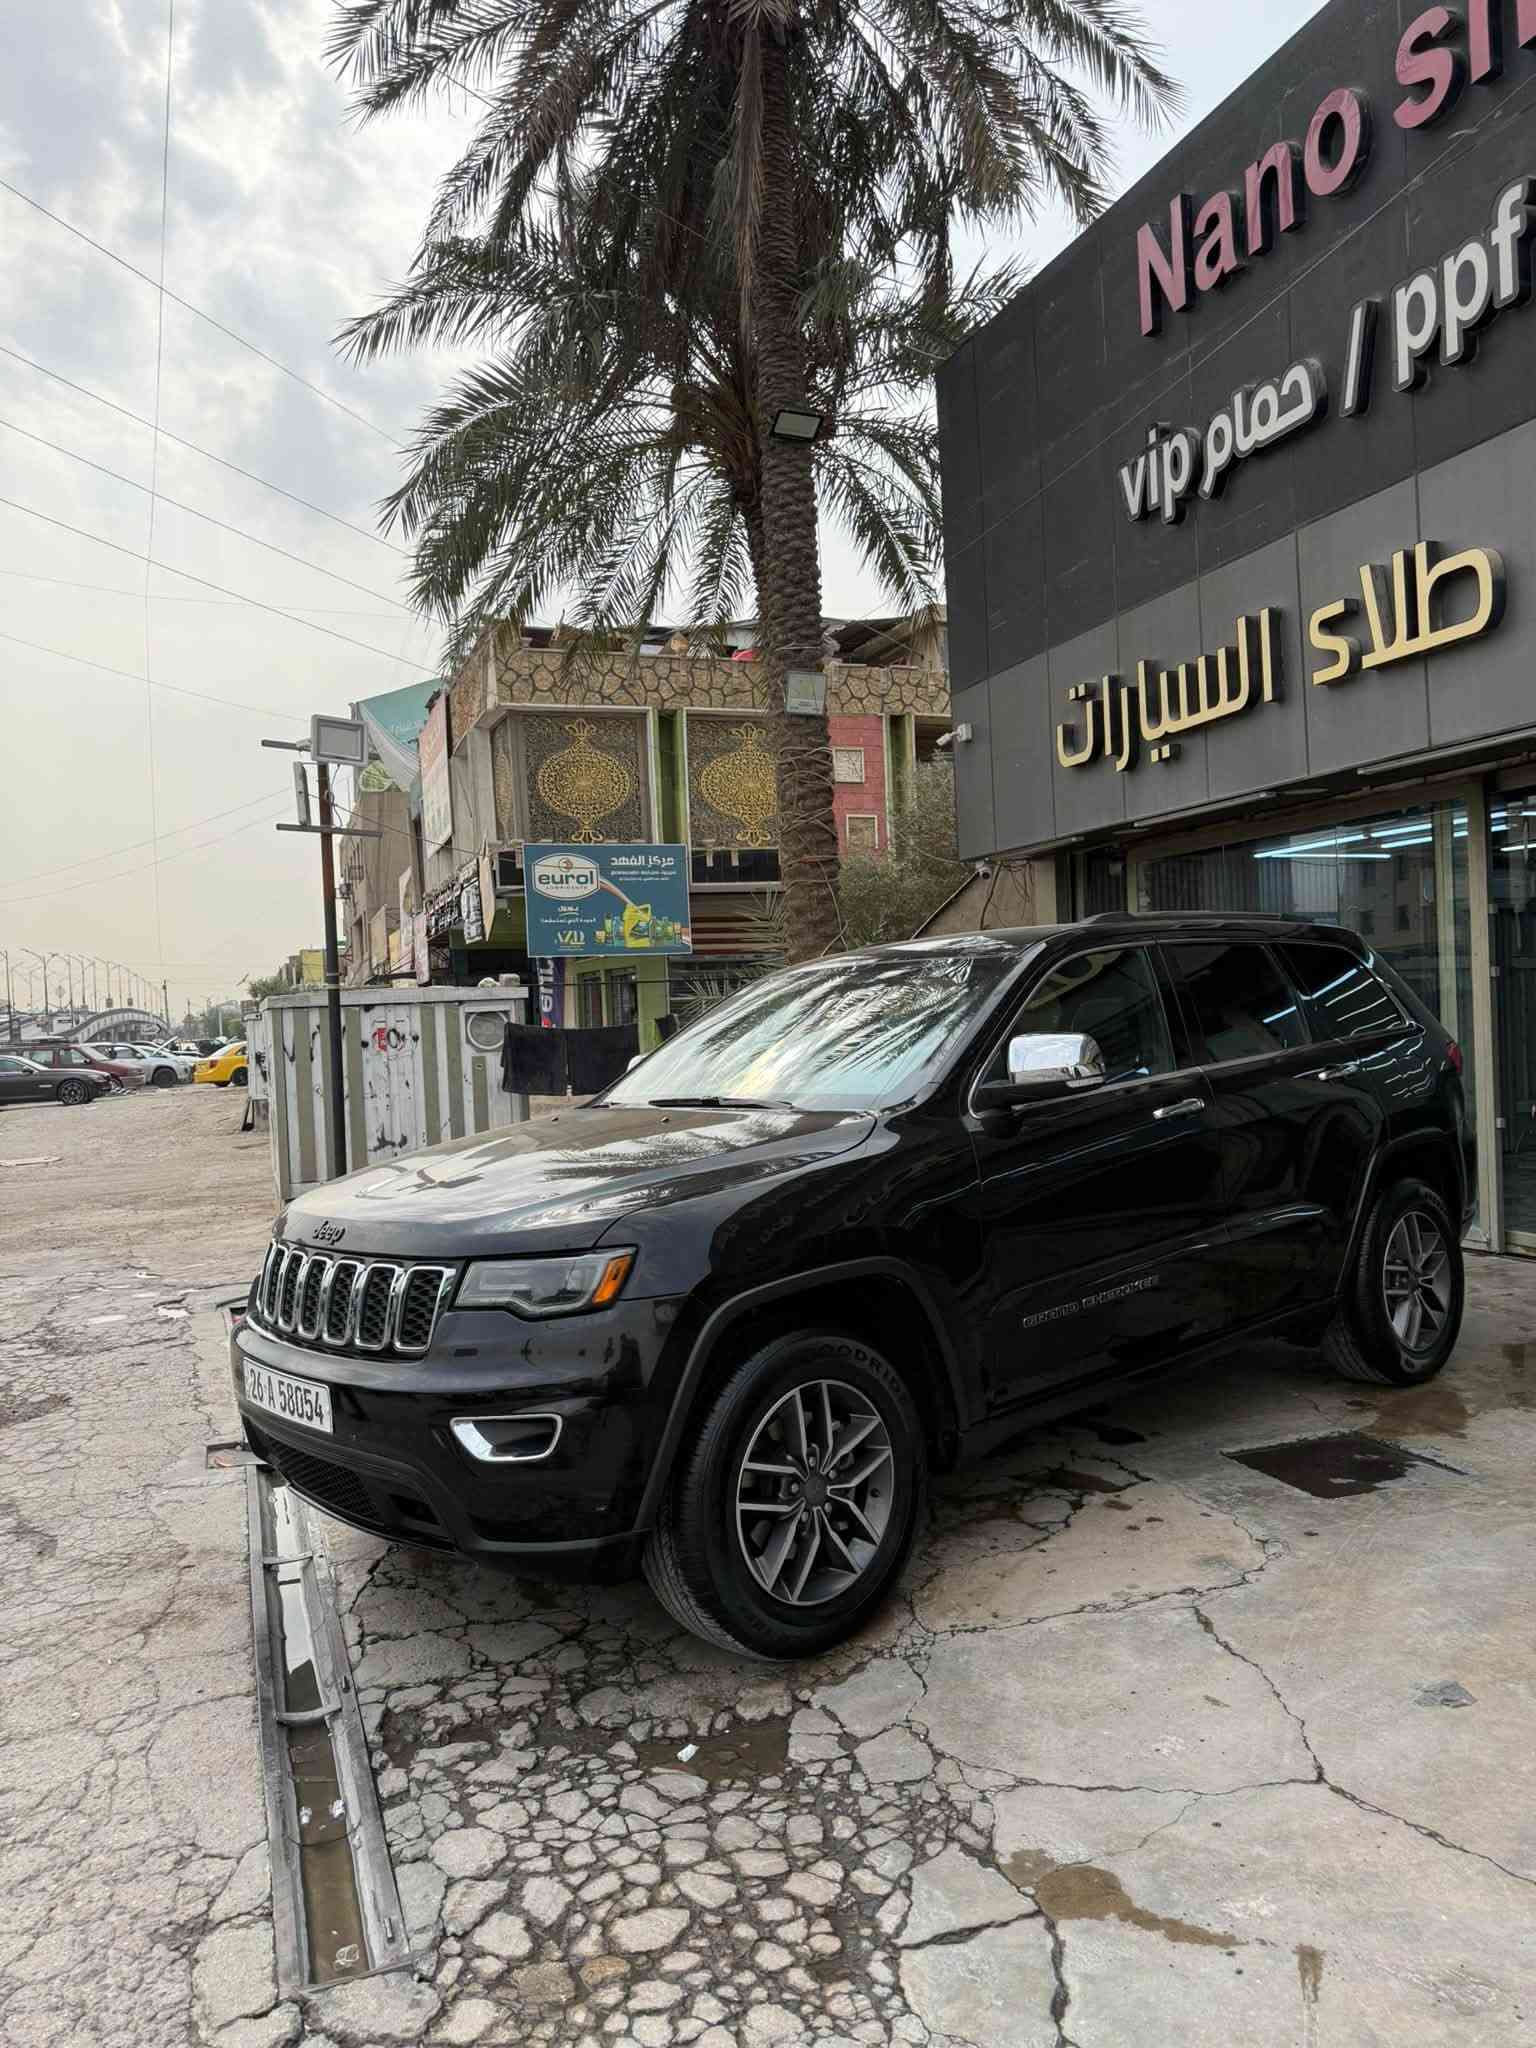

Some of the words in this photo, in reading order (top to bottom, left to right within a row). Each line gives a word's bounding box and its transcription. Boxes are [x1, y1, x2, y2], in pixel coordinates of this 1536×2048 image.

[1137, 87, 1361, 336] Nano
[1395, 184, 1524, 385] ppf
[1120, 428, 1191, 519] vip
[1200, 364, 1313, 494] حمام
[1308, 540, 1495, 686] طلاء
[1056, 607, 1274, 772] السيارات
[538, 870, 594, 885] eurol
[610, 855, 646, 866] الفهد
[647, 855, 675, 868] مركز
[312, 1220, 346, 1246] Jeep
[249, 1368, 264, 1402] 26
[268, 1375, 276, 1409] A
[278, 1380, 324, 1425] 58054
